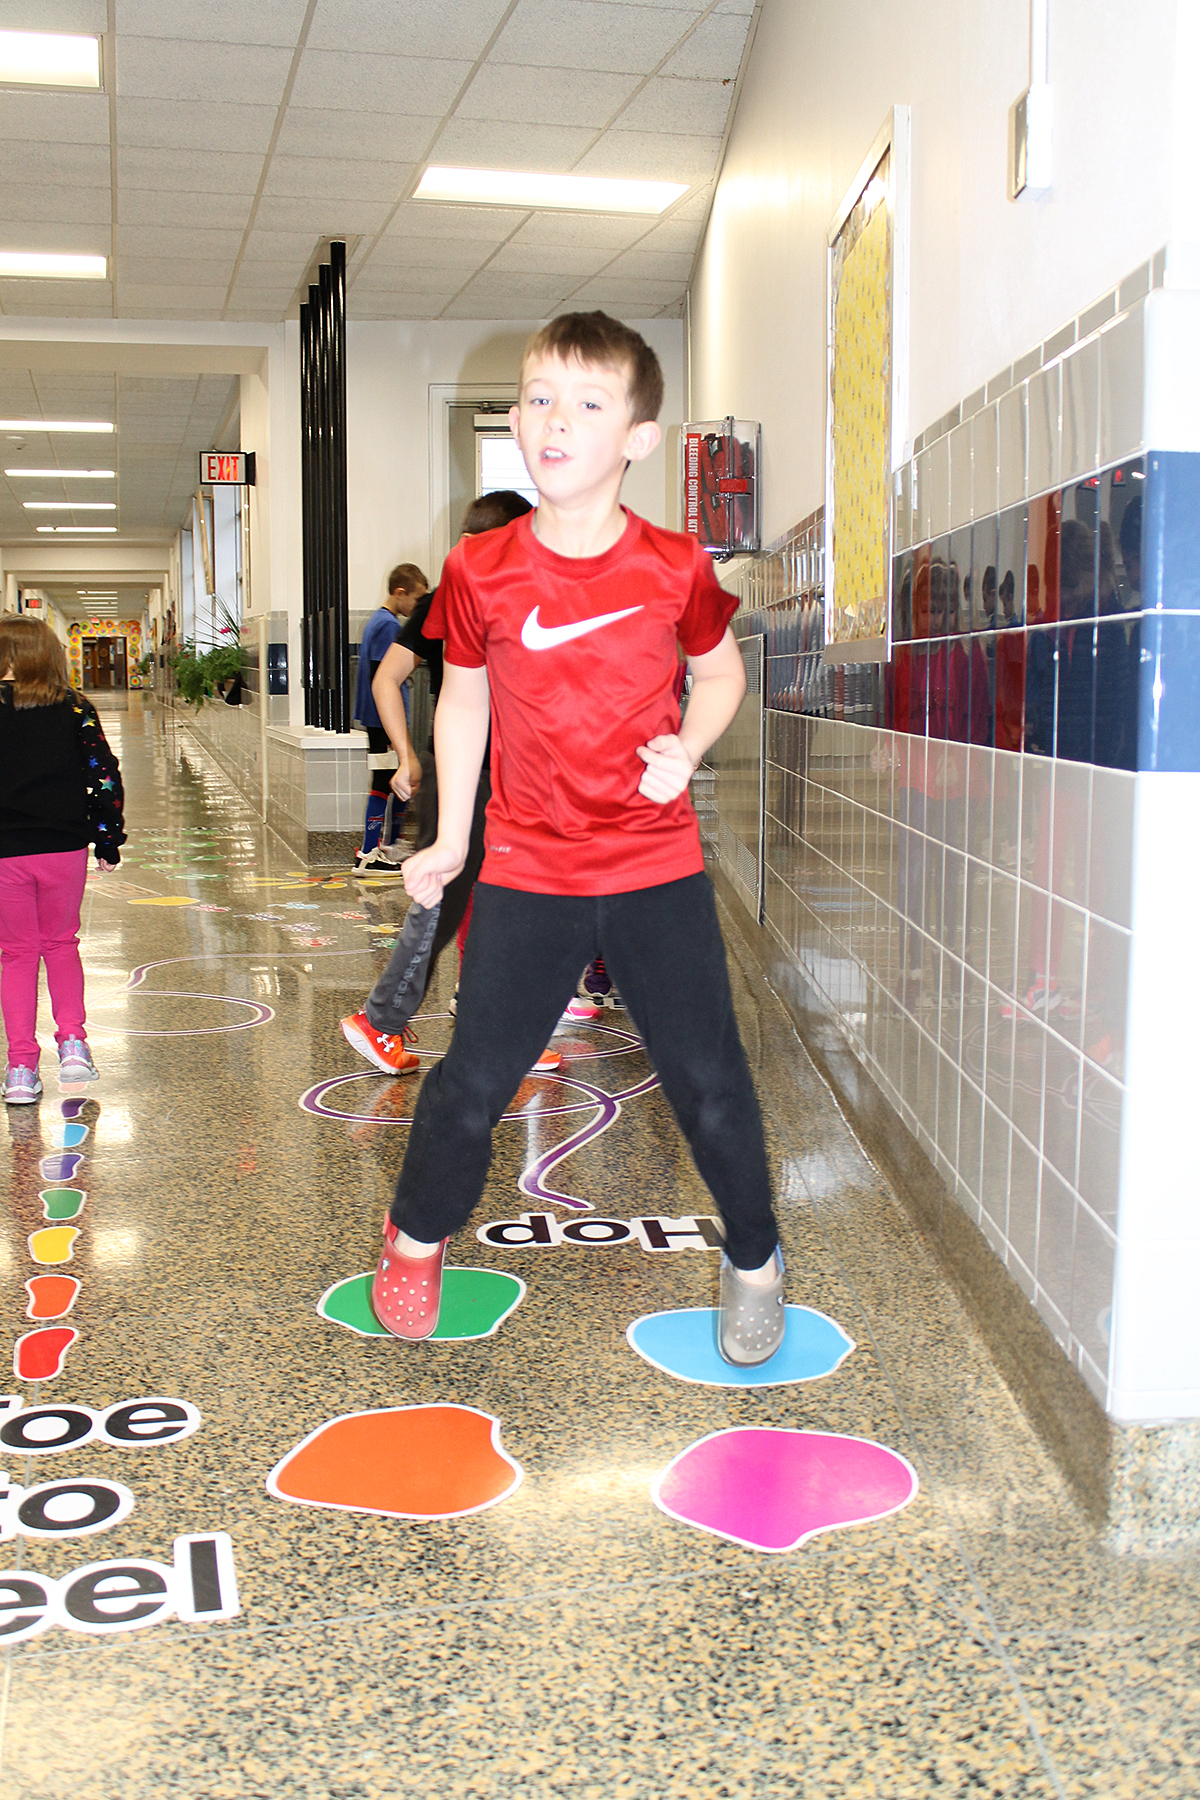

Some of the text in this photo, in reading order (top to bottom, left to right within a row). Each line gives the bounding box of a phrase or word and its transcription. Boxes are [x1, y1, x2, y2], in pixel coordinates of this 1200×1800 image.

[207, 456, 239, 481] EXIT
[687, 437, 699, 533] BLEEDING CONTROL KIT
[391, 954, 421, 1009] ARMOUR
[486, 1215, 727, 1248] Hop
[0, 1401, 188, 1448] oe
